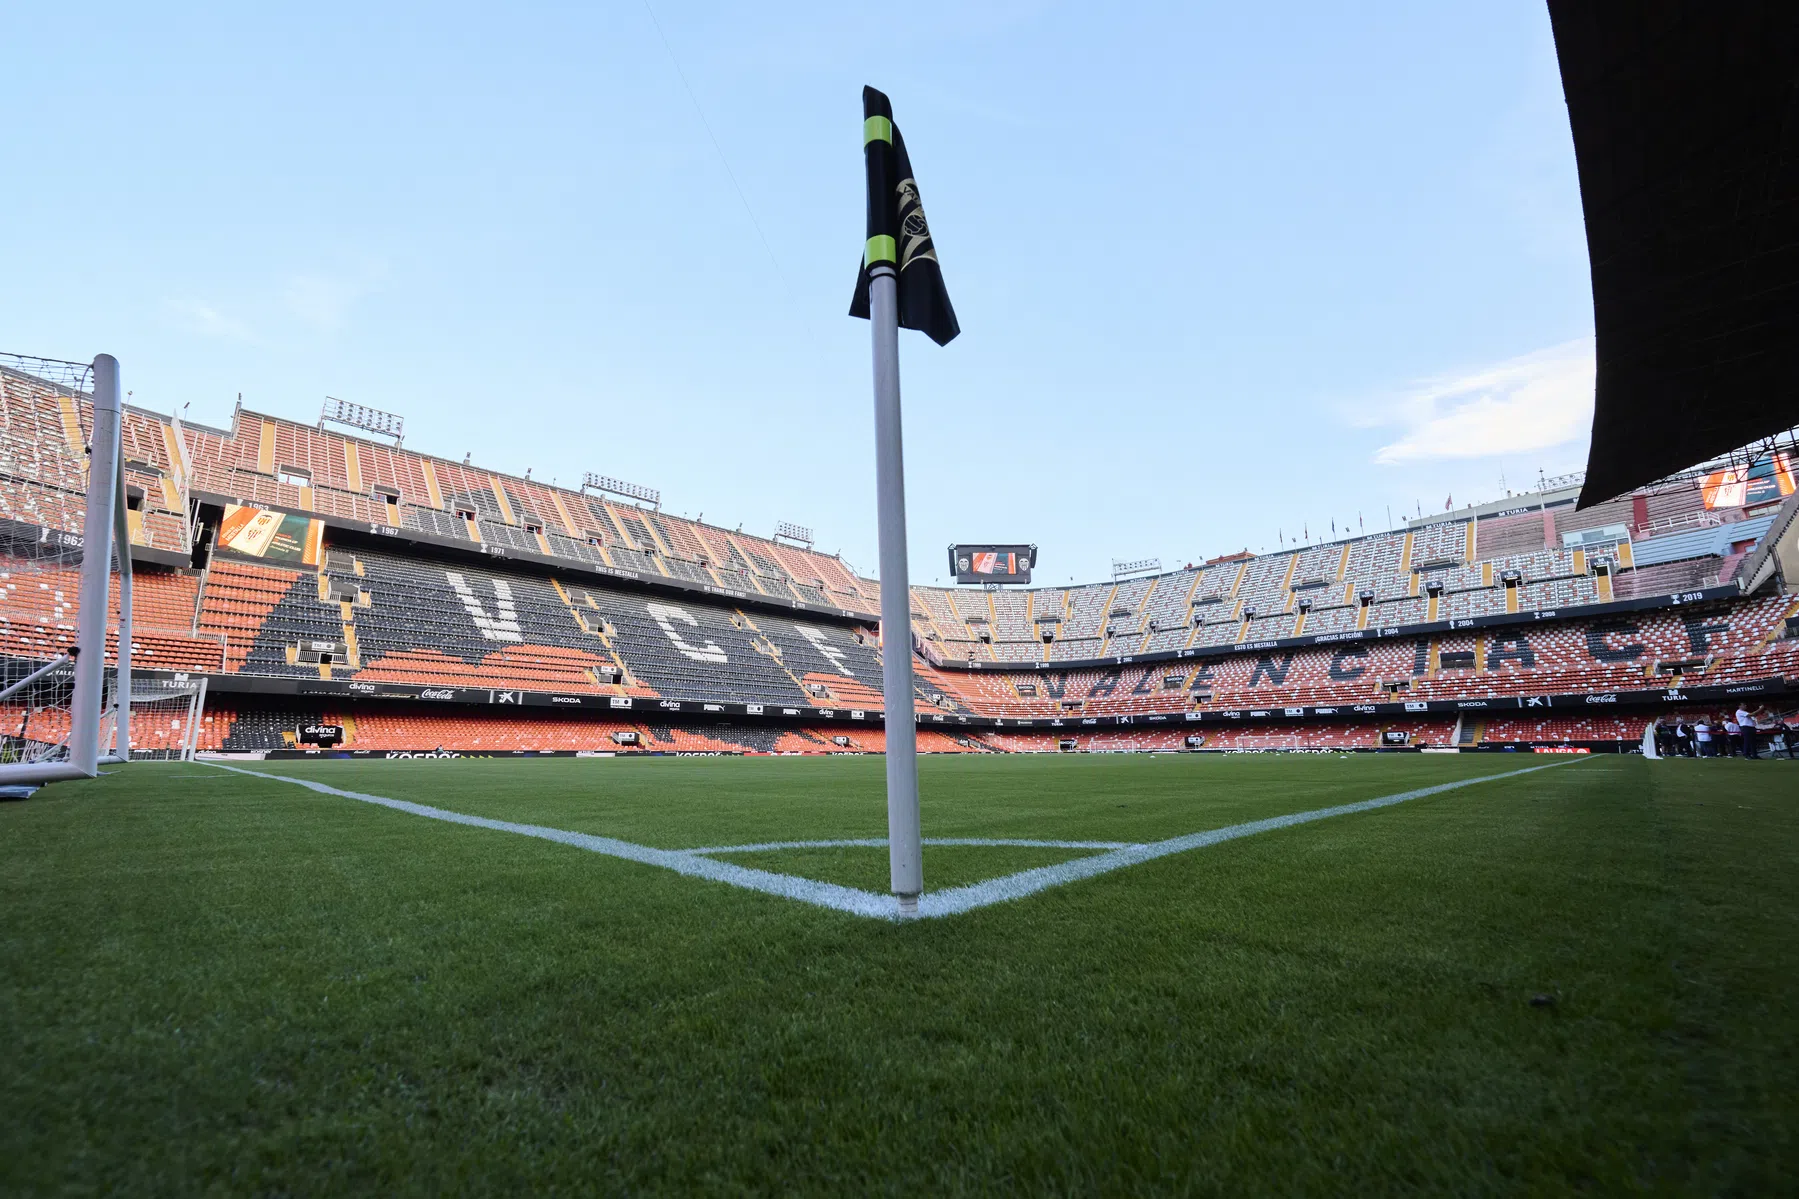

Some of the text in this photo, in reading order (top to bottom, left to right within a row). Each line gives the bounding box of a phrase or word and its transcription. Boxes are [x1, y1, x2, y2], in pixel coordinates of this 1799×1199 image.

[1506, 508, 1528, 516] TURIA
[382, 526, 398, 535] 1967
[58, 534, 84, 547] 1962
[490, 546, 505, 554] 1971
[596, 566, 606, 574] THIS
[614, 568, 638, 578] MESTALLA
[1682, 591, 1703, 602] 2019
[162, 680, 197, 689] TURIA
[1726, 685, 1764, 694] MARTINELLI
[305, 726, 336, 734] divina
